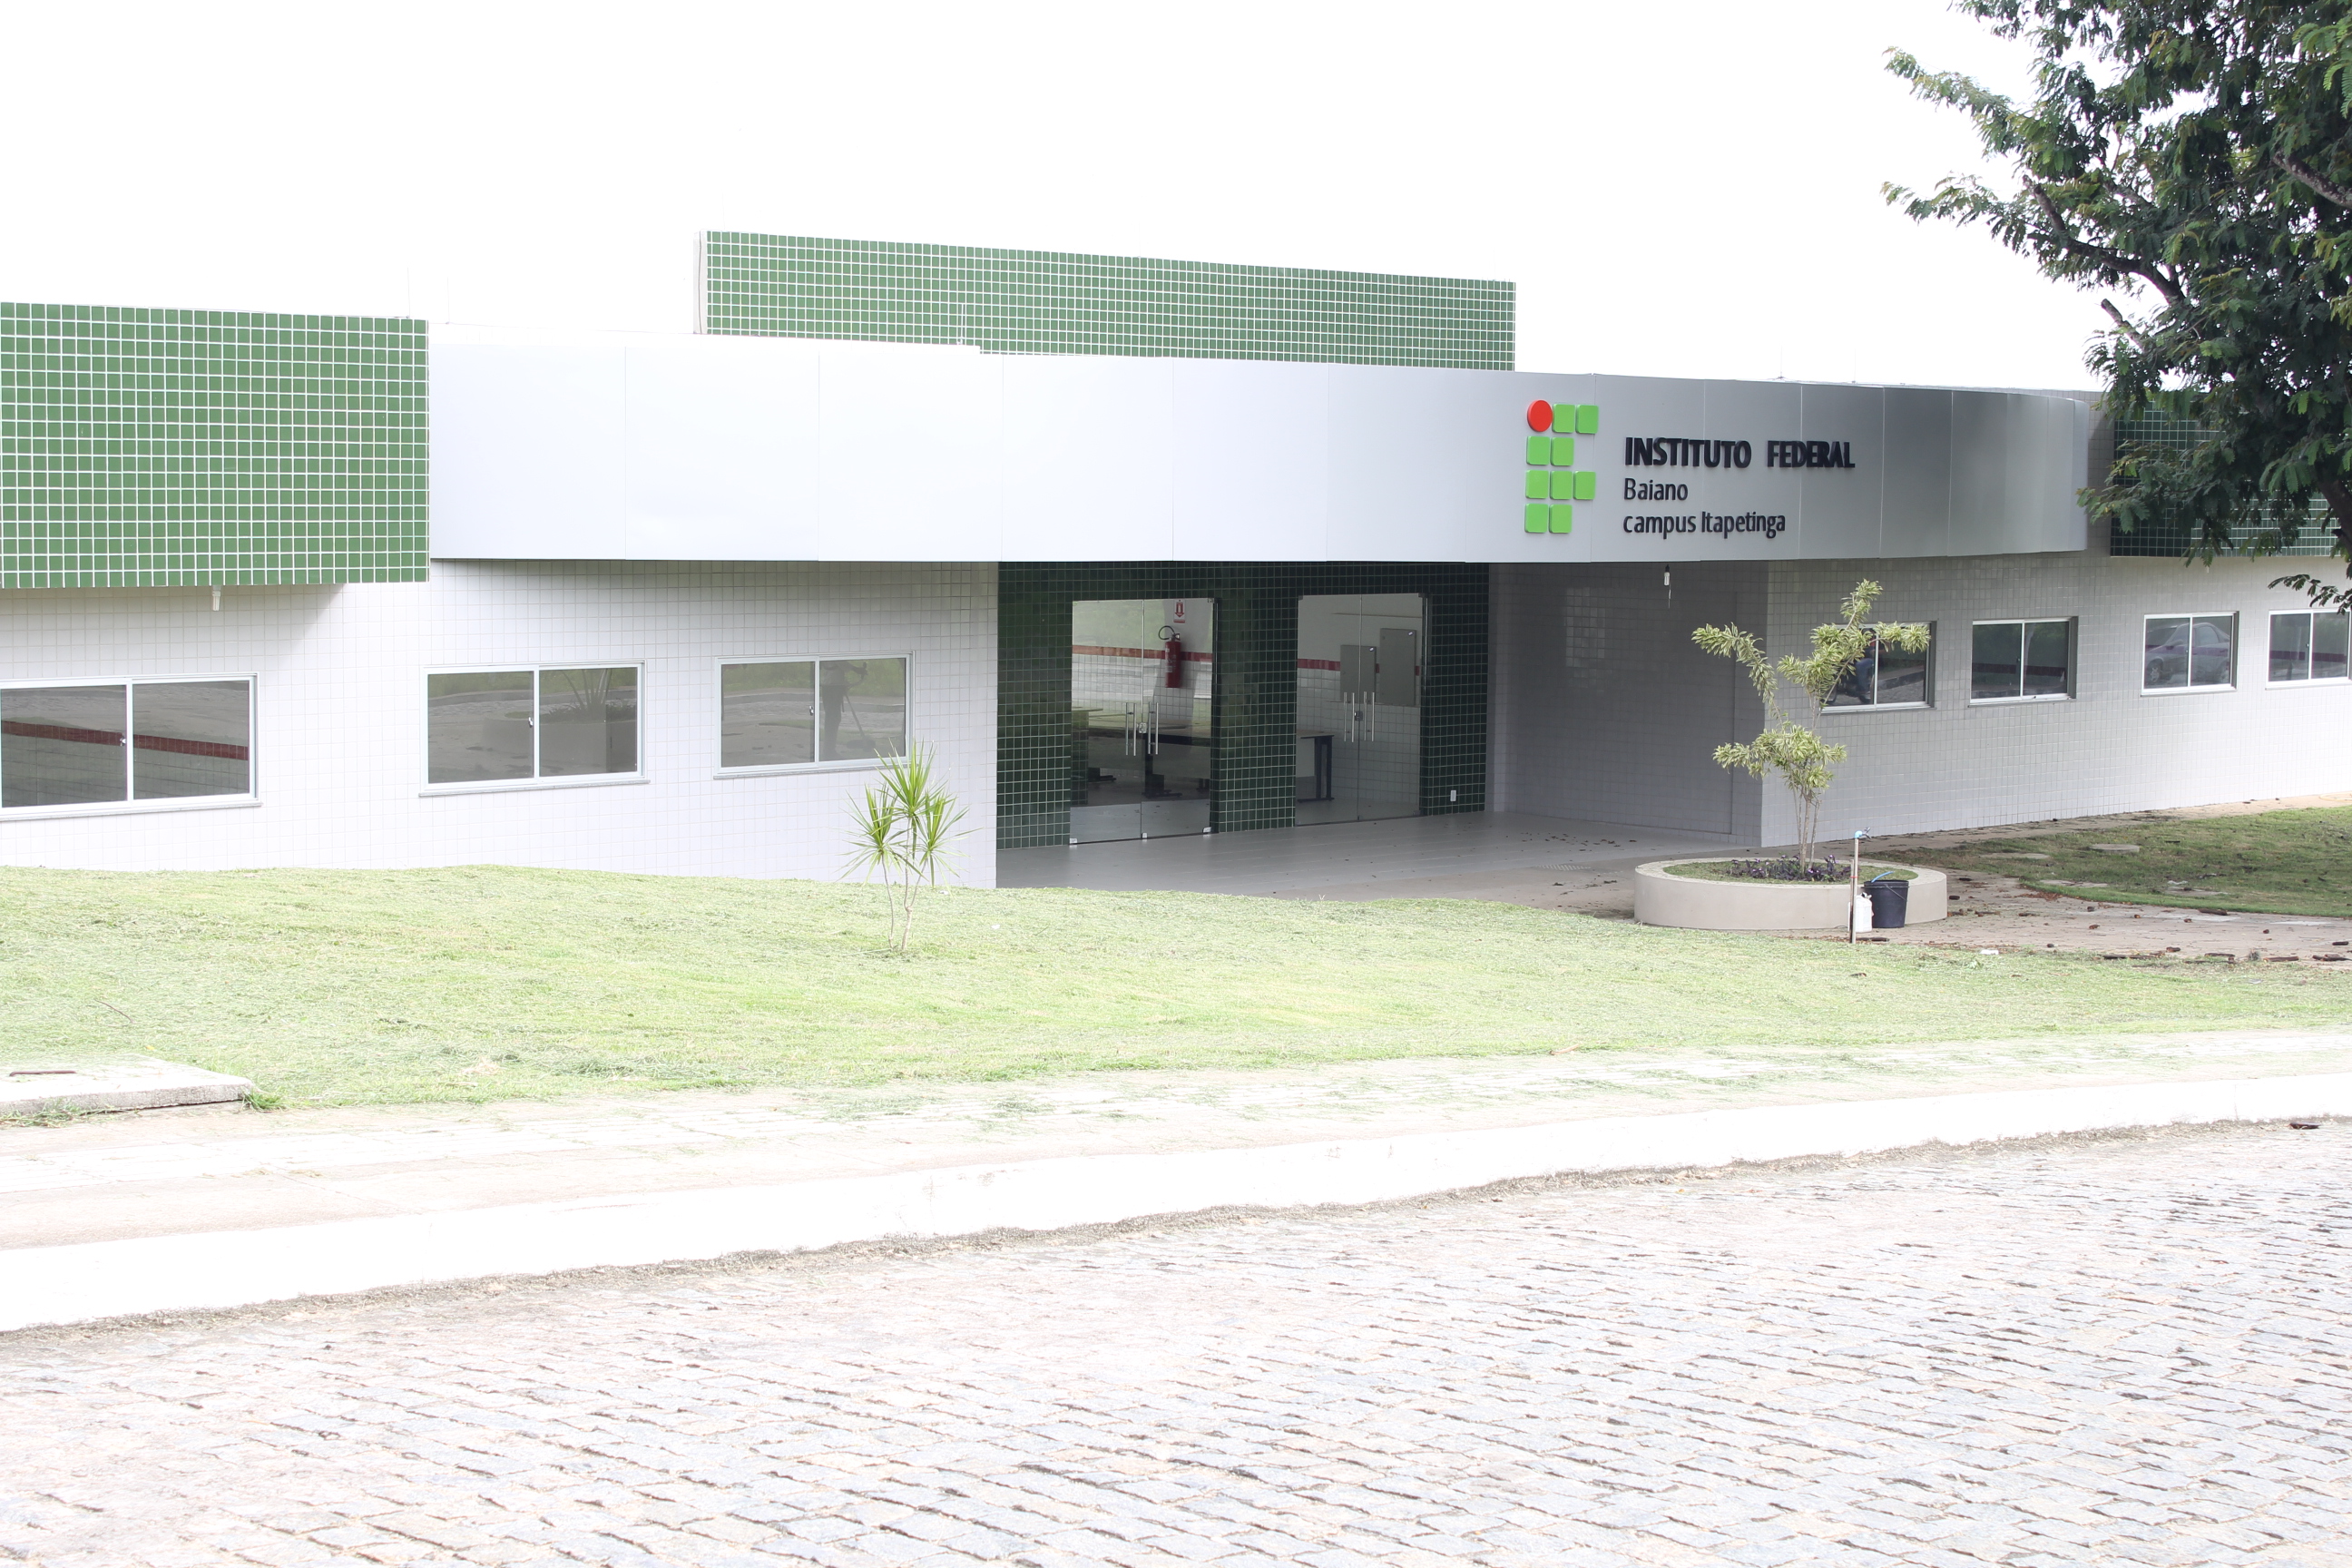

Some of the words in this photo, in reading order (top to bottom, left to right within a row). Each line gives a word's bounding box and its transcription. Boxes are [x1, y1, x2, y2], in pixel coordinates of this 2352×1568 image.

[1624, 437, 1752, 469] INSTITUTO
[1767, 440, 1856, 469] FEDERAL
[1623, 477, 1689, 501] Baiano
[1622, 514, 1697, 540] campus
[1700, 511, 1787, 539] Itapetinga
